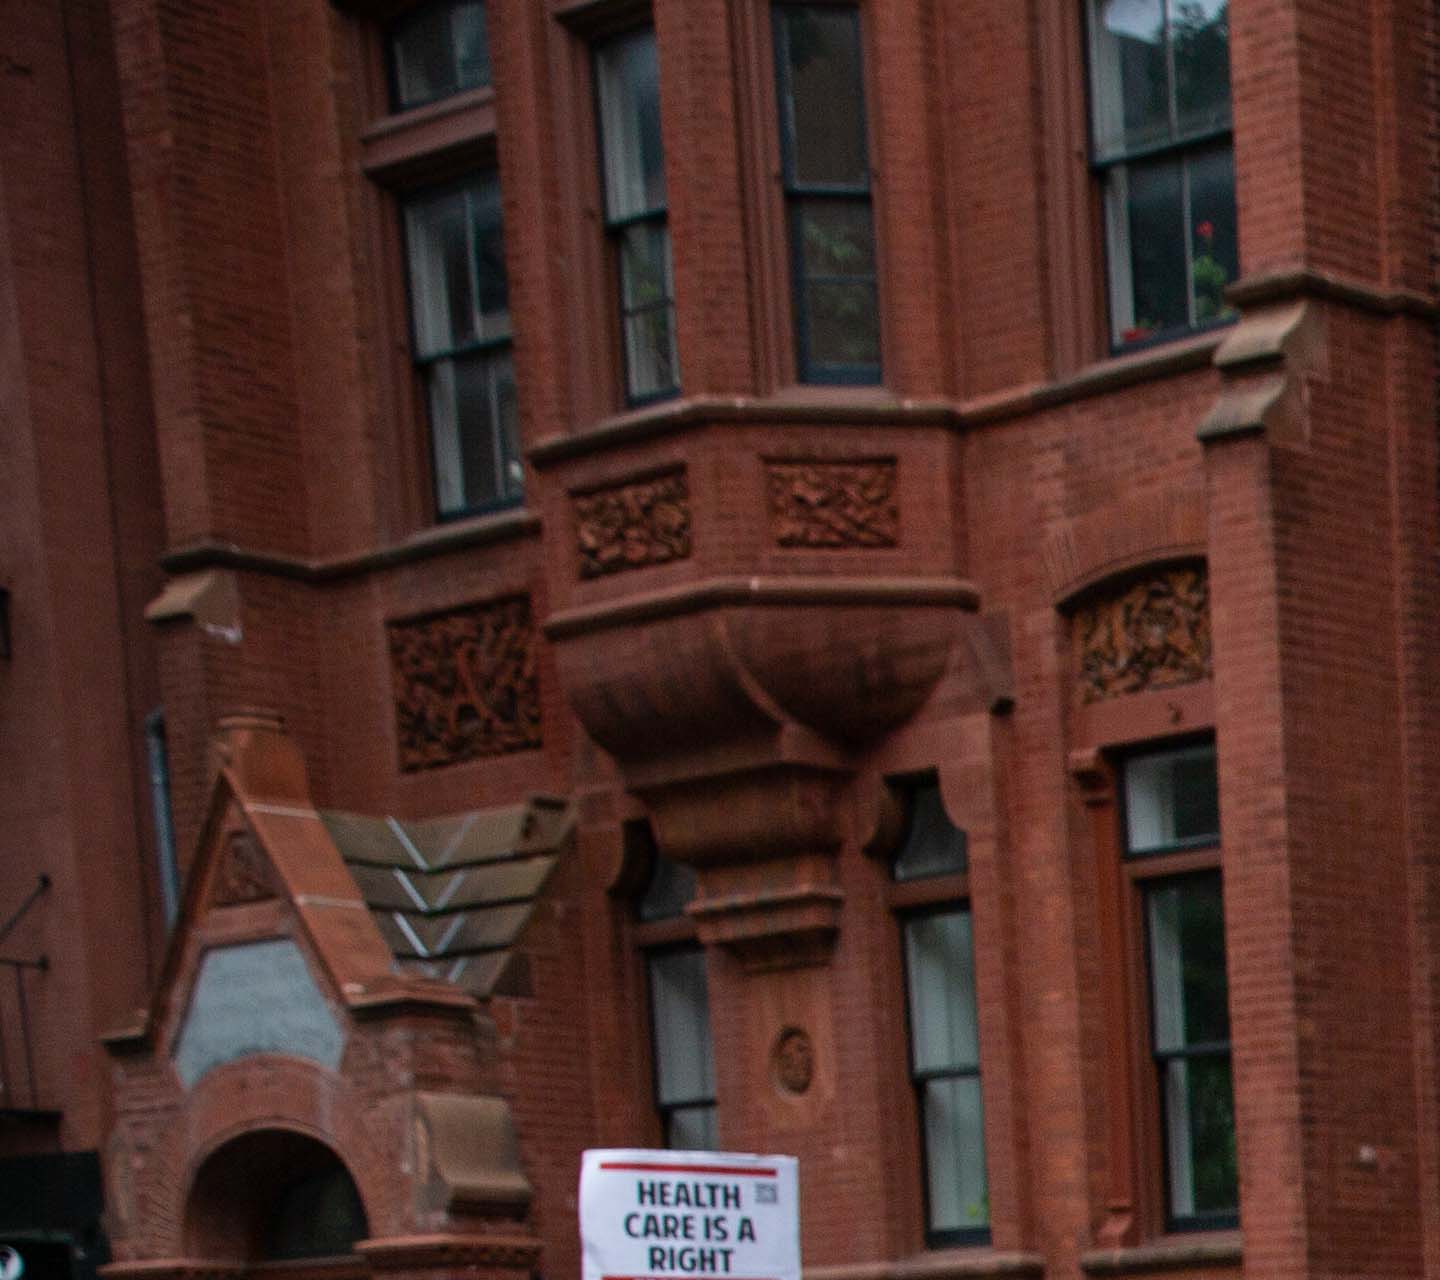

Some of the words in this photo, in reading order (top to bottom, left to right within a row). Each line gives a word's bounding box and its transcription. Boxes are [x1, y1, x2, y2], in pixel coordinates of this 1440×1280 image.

[637, 1180, 741, 1210] HEALTH
[624, 1212, 696, 1240] CARE
[703, 1214, 729, 1242] IS
[737, 1217, 757, 1243] A
[648, 1245, 735, 1273] RIGHT
